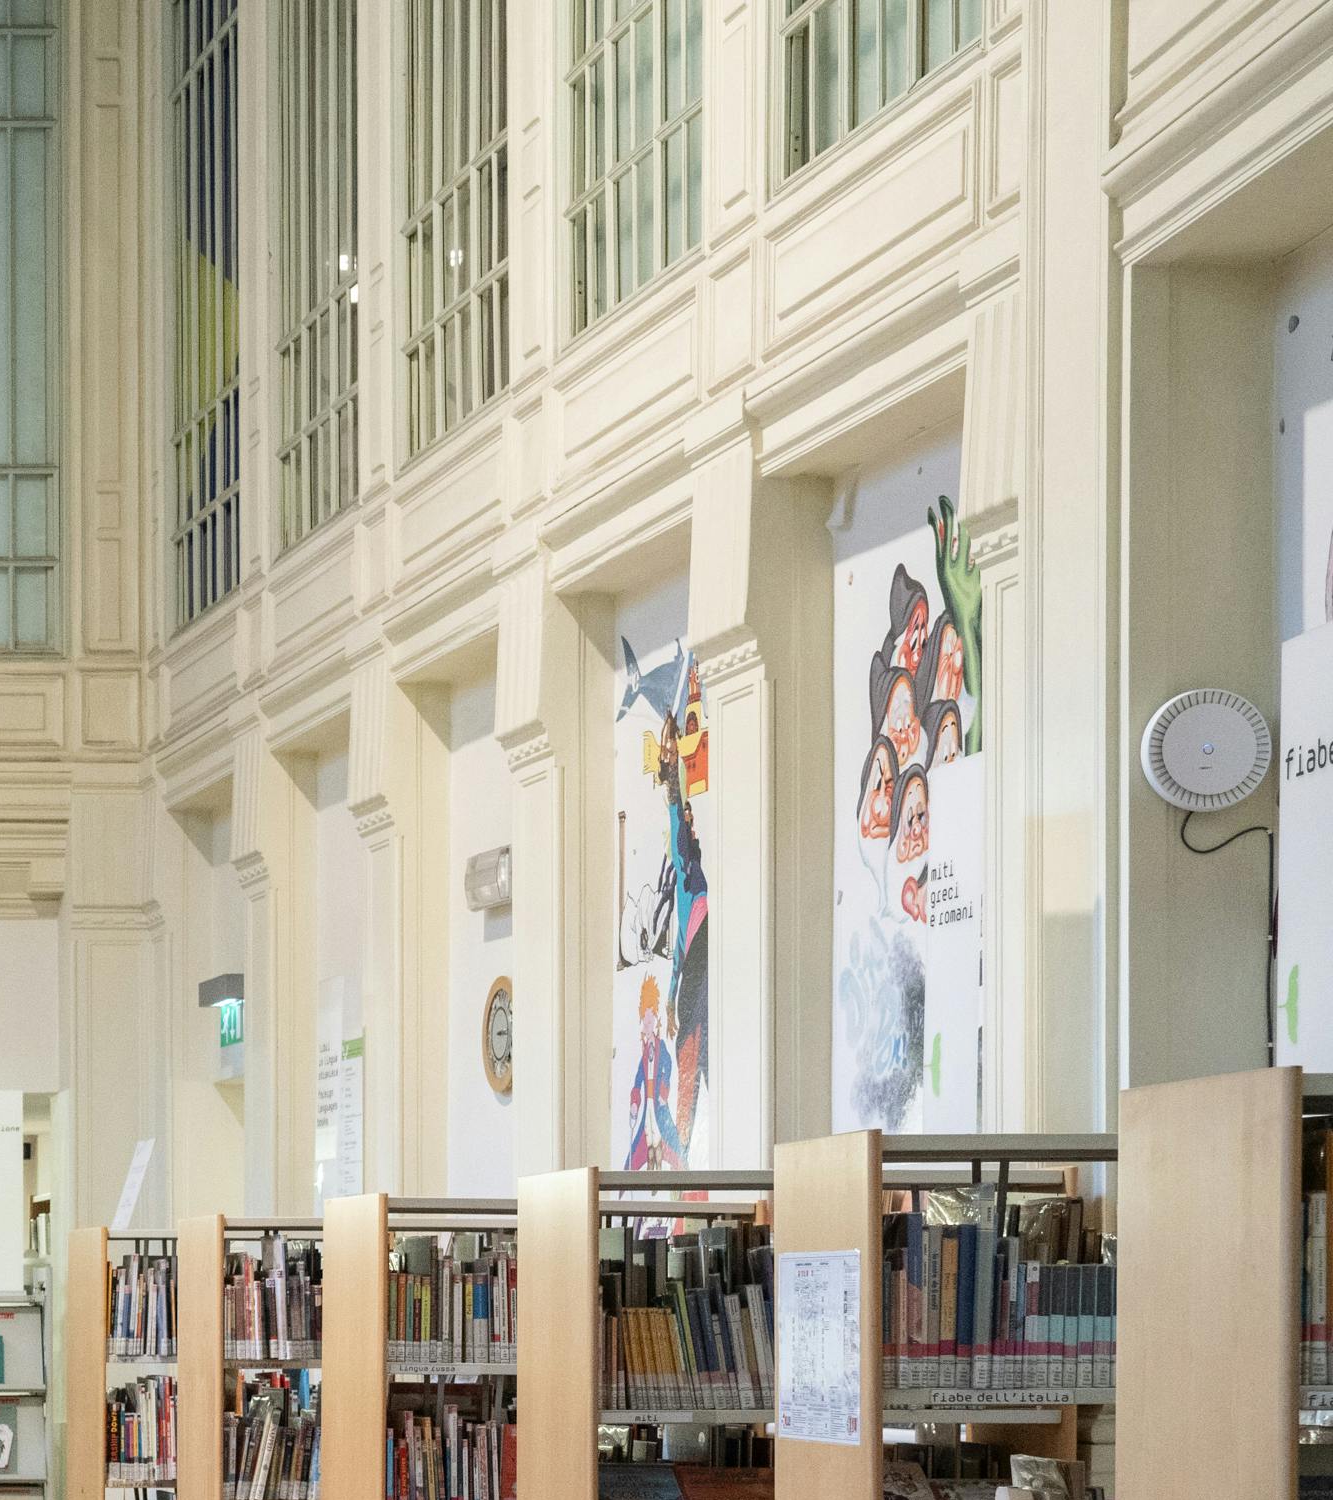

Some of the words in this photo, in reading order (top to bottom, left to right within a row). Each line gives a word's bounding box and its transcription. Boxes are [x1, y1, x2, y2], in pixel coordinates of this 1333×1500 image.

[930, 859, 954, 881] miti
[930, 882, 959, 909] greci
[930, 914, 936, 928] e
[938, 901, 973, 926] romani
[932, 1392, 972, 1403] fiabe
[977, 1392, 1069, 1403] dell'italia
[634, 1413, 659, 1422] miti
